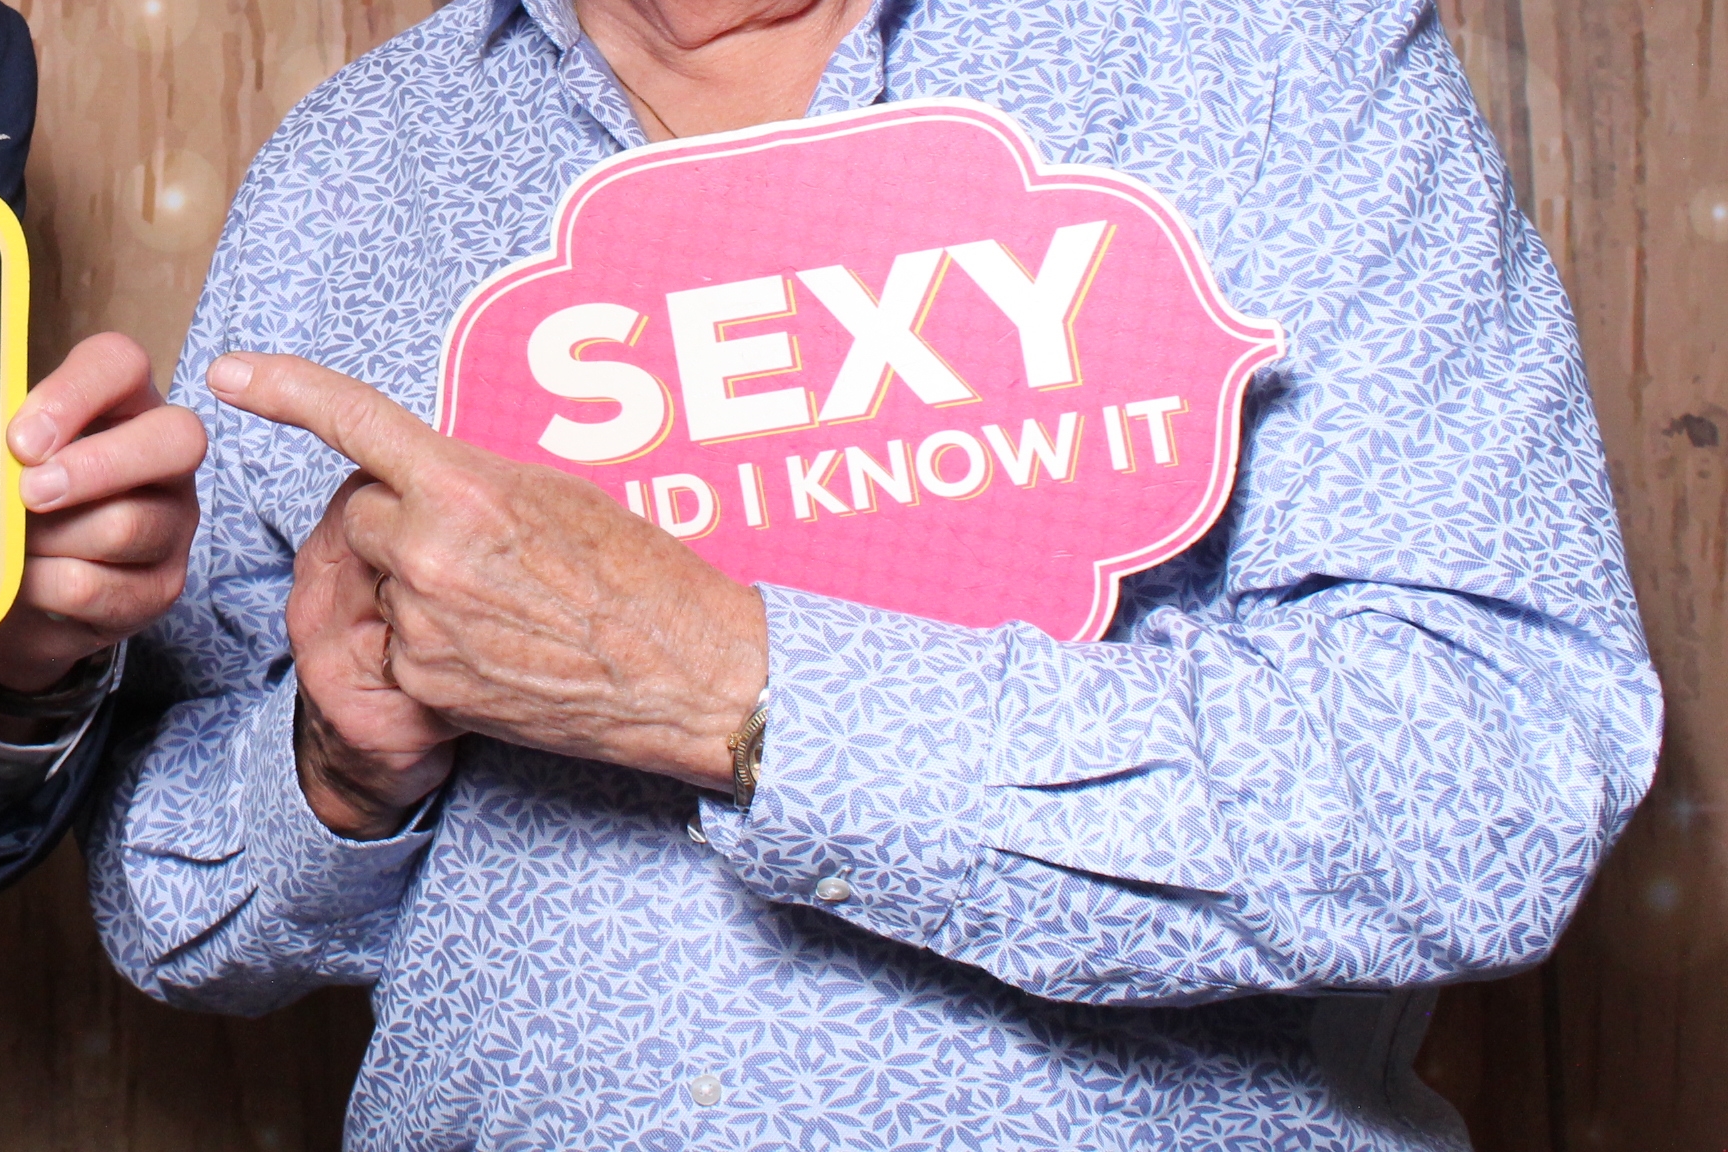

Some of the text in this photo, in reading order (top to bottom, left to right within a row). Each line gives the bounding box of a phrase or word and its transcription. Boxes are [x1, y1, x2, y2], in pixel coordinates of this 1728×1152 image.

[527, 219, 1115, 464] SEXY
[738, 462, 768, 529] I
[786, 410, 1083, 522] KNOW
[1103, 396, 1189, 474] IT
